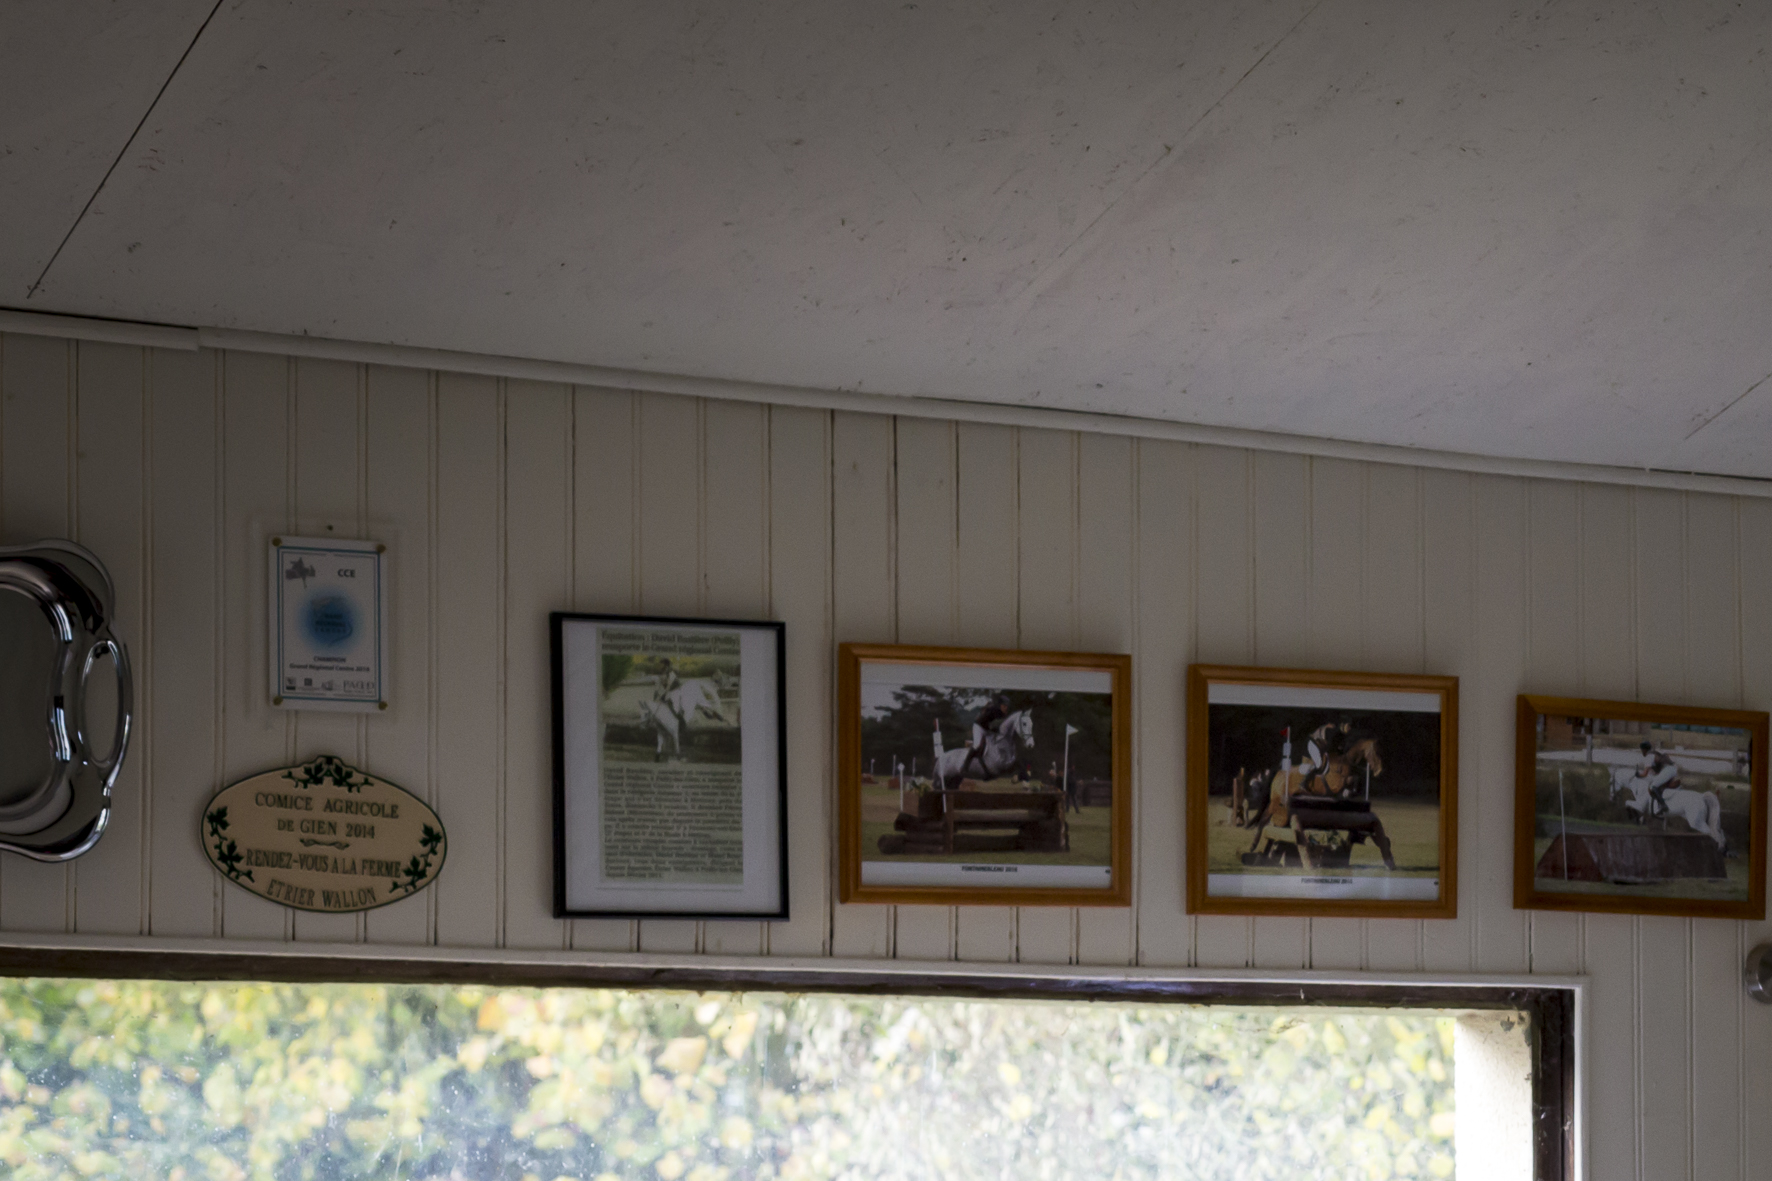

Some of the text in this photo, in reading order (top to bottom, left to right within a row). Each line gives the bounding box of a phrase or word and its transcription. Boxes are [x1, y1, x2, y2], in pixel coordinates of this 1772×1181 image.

[337, 569, 355, 578] CCE
[255, 792, 400, 819] COMICE AGRICOLE
[277, 818, 376, 839] DE GIEN 2014
[246, 849, 329, 872] RENDEZ-VOUS
[341, 857, 357, 875] LA
[361, 858, 402, 878] FERME
[266, 879, 377, 909] ETRIER WALLON
